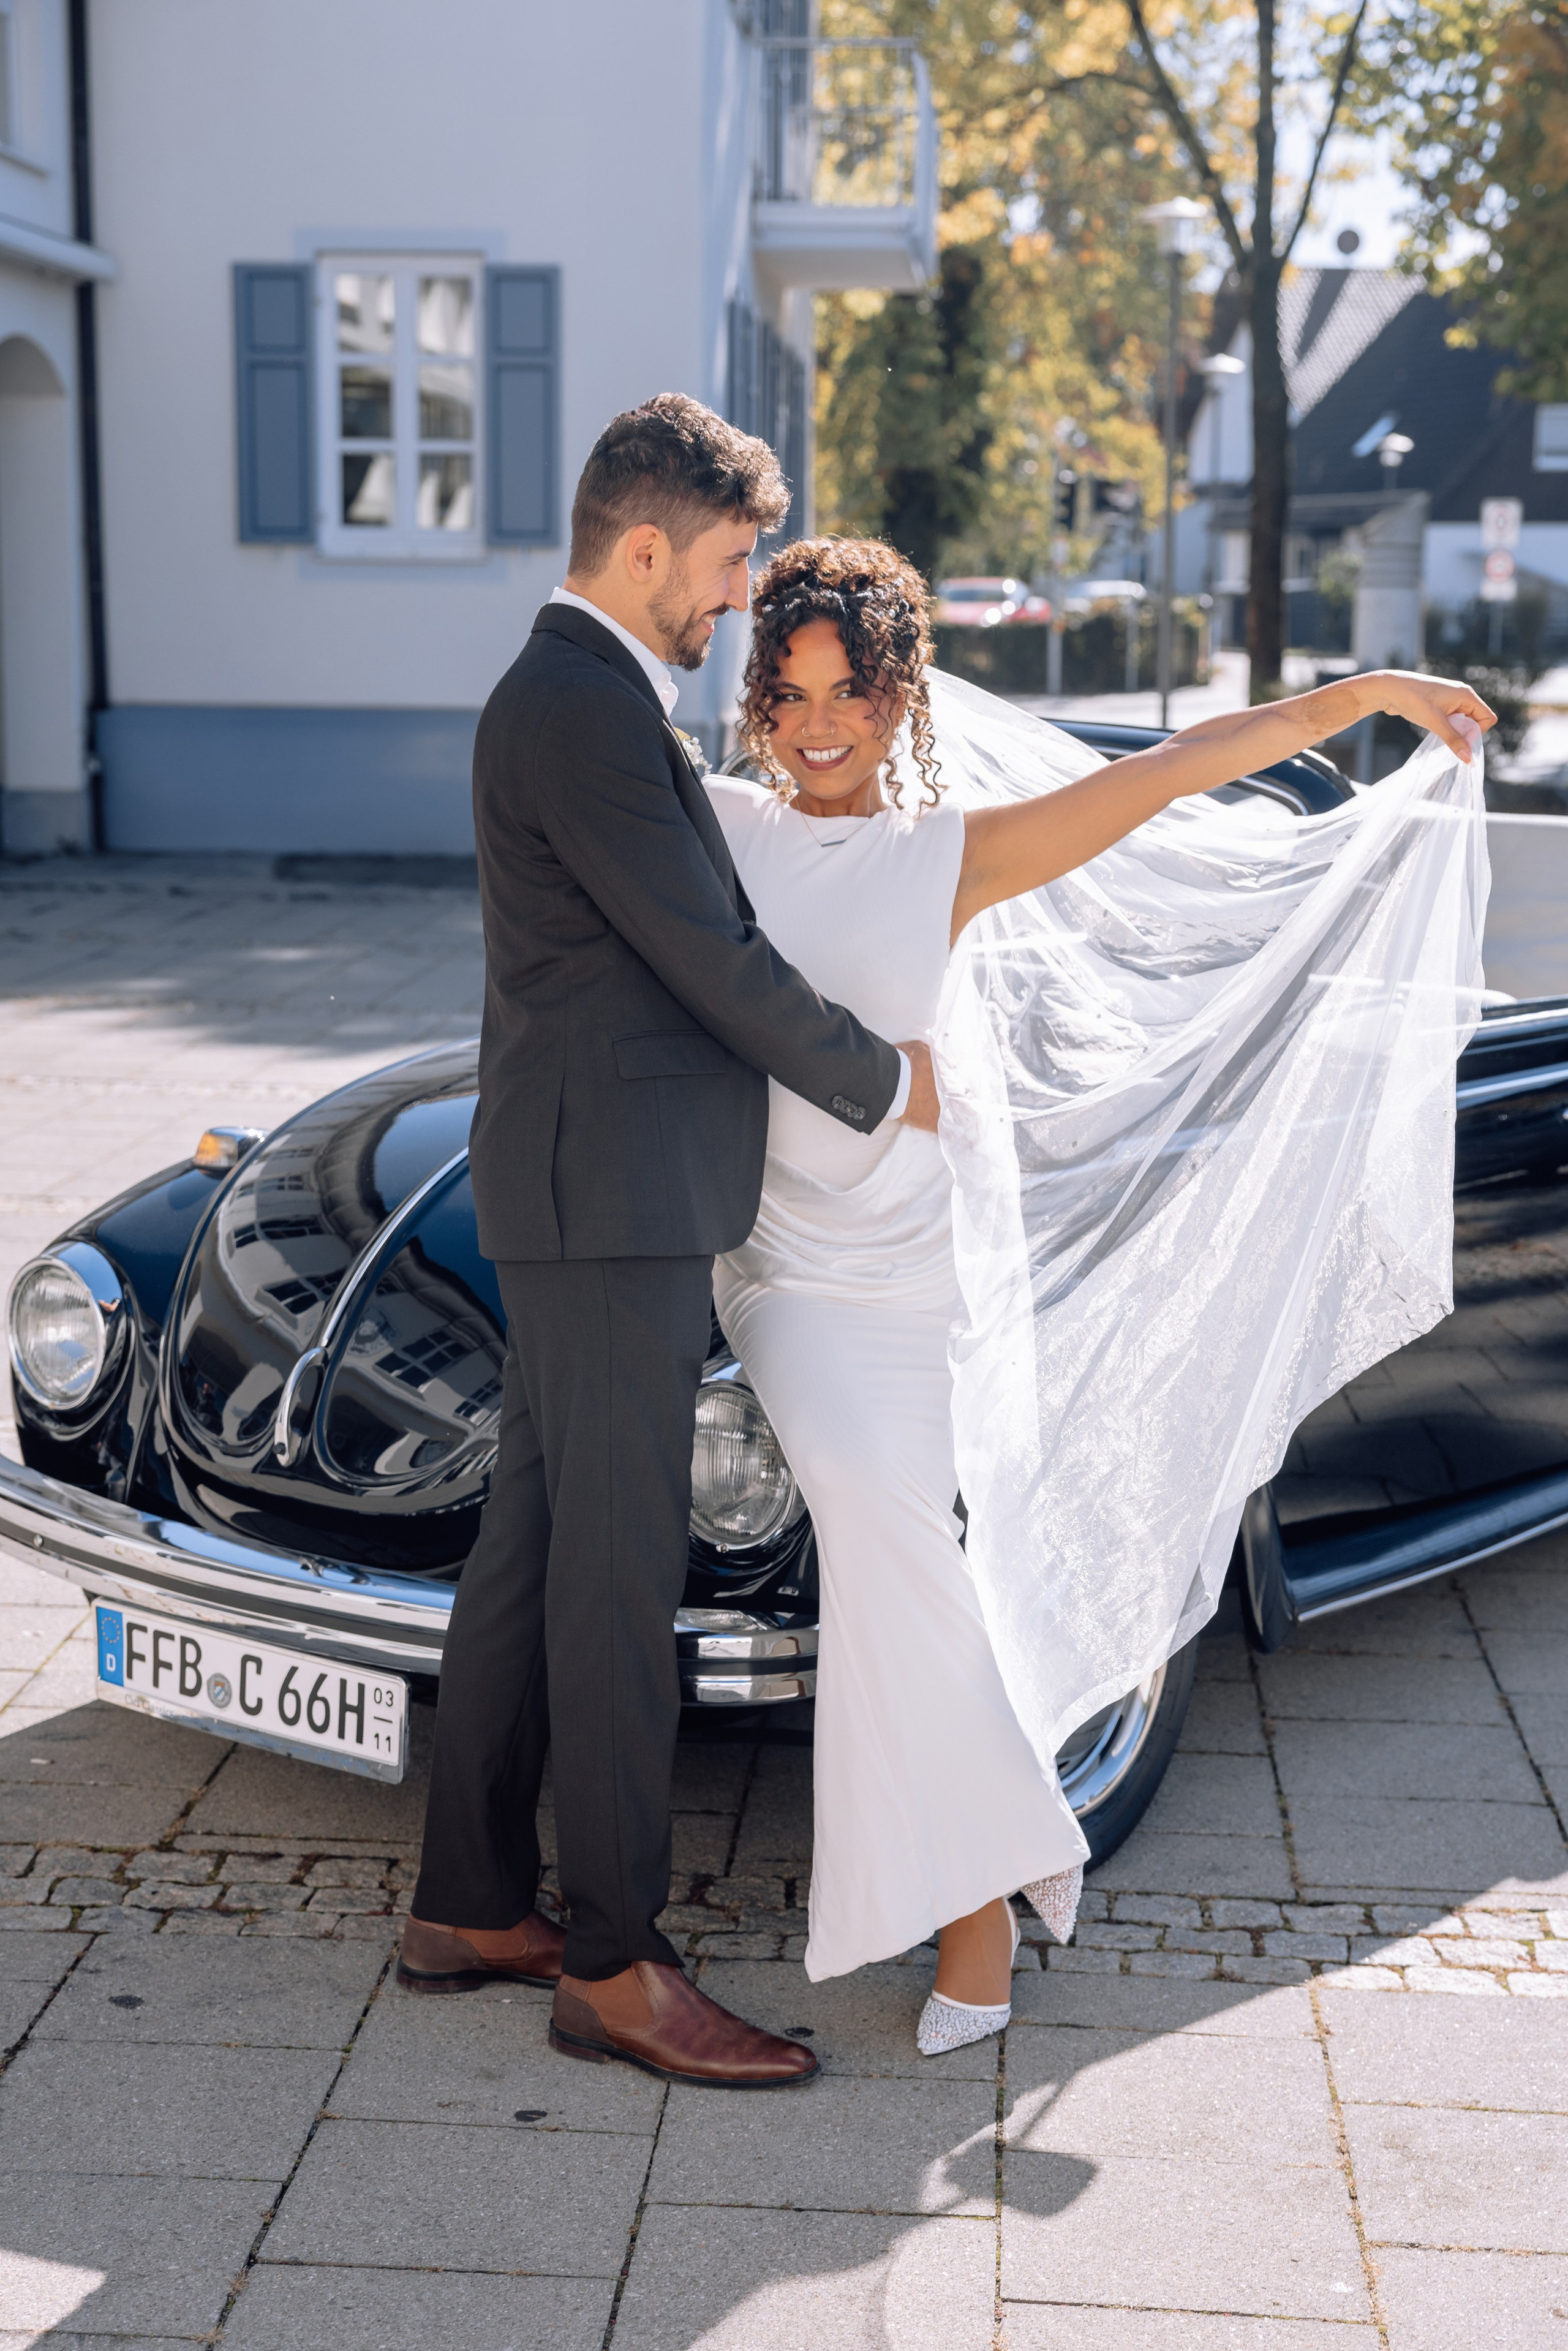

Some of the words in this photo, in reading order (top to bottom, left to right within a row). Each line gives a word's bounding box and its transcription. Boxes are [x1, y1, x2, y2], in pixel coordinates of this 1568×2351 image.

[106, 1653, 116, 1672] D
[126, 1621, 202, 1697] FFB
[239, 1654, 263, 1716] C
[278, 1666, 366, 1745] 66H
[374, 1688, 394, 1707] 03
[374, 1733, 392, 1753] 11
